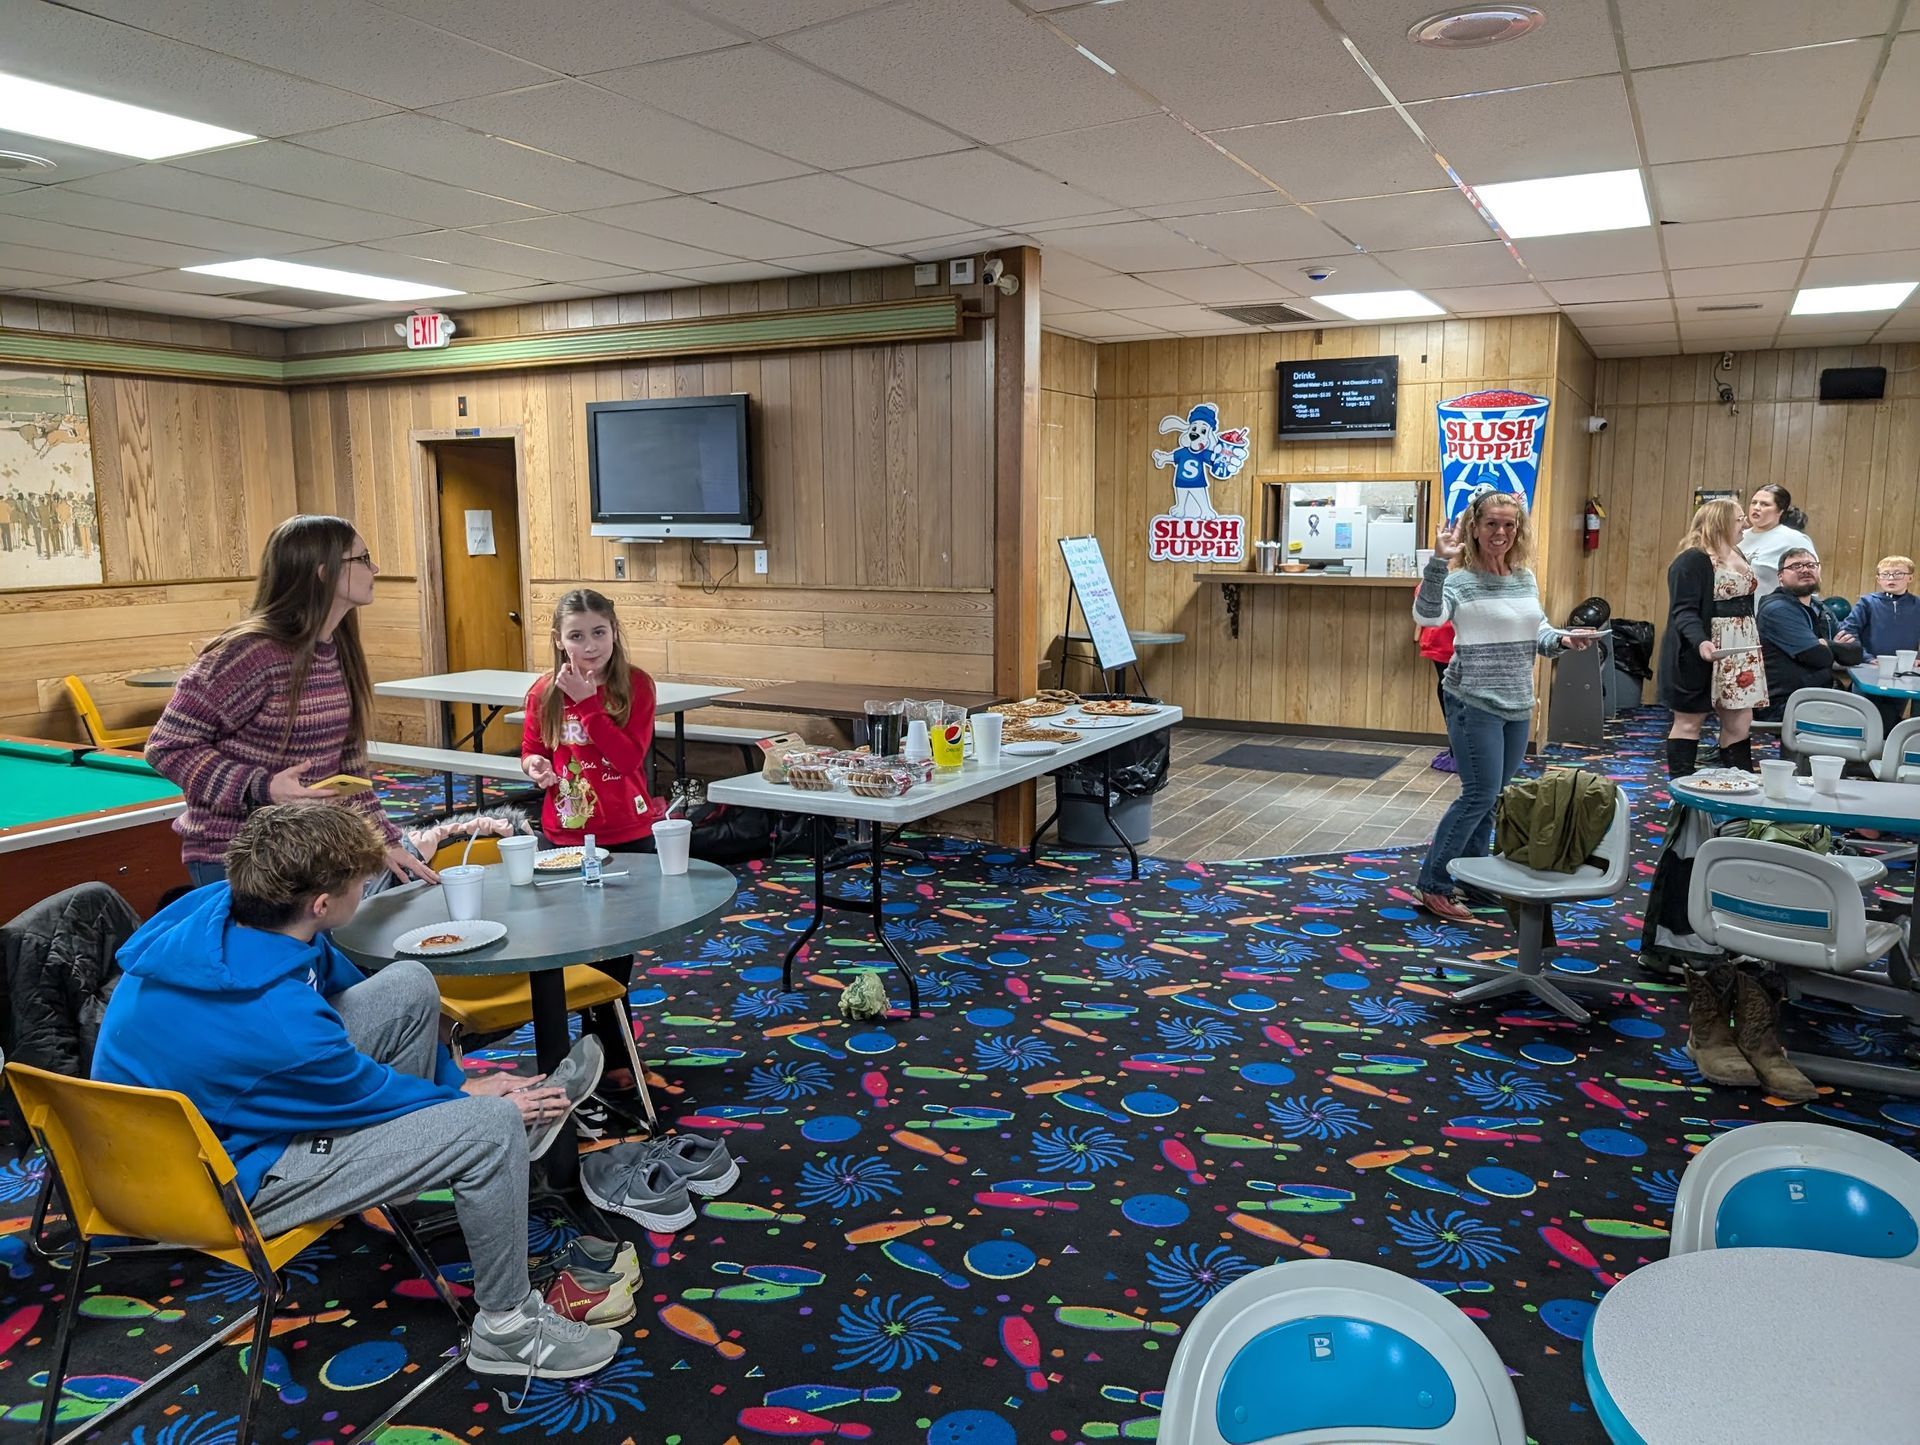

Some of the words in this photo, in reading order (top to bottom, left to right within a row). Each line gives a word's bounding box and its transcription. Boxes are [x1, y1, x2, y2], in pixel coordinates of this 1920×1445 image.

[413, 316, 438, 345] EXIT
[1293, 371, 1316, 380] Drinks
[1446, 418, 1535, 442] SLUSH
[1182, 459, 1199, 479] S
[1154, 520, 1239, 540] SLUSH
[570, 1298, 592, 1307] RENTAL
[1314, 1337, 1331, 1357] B
